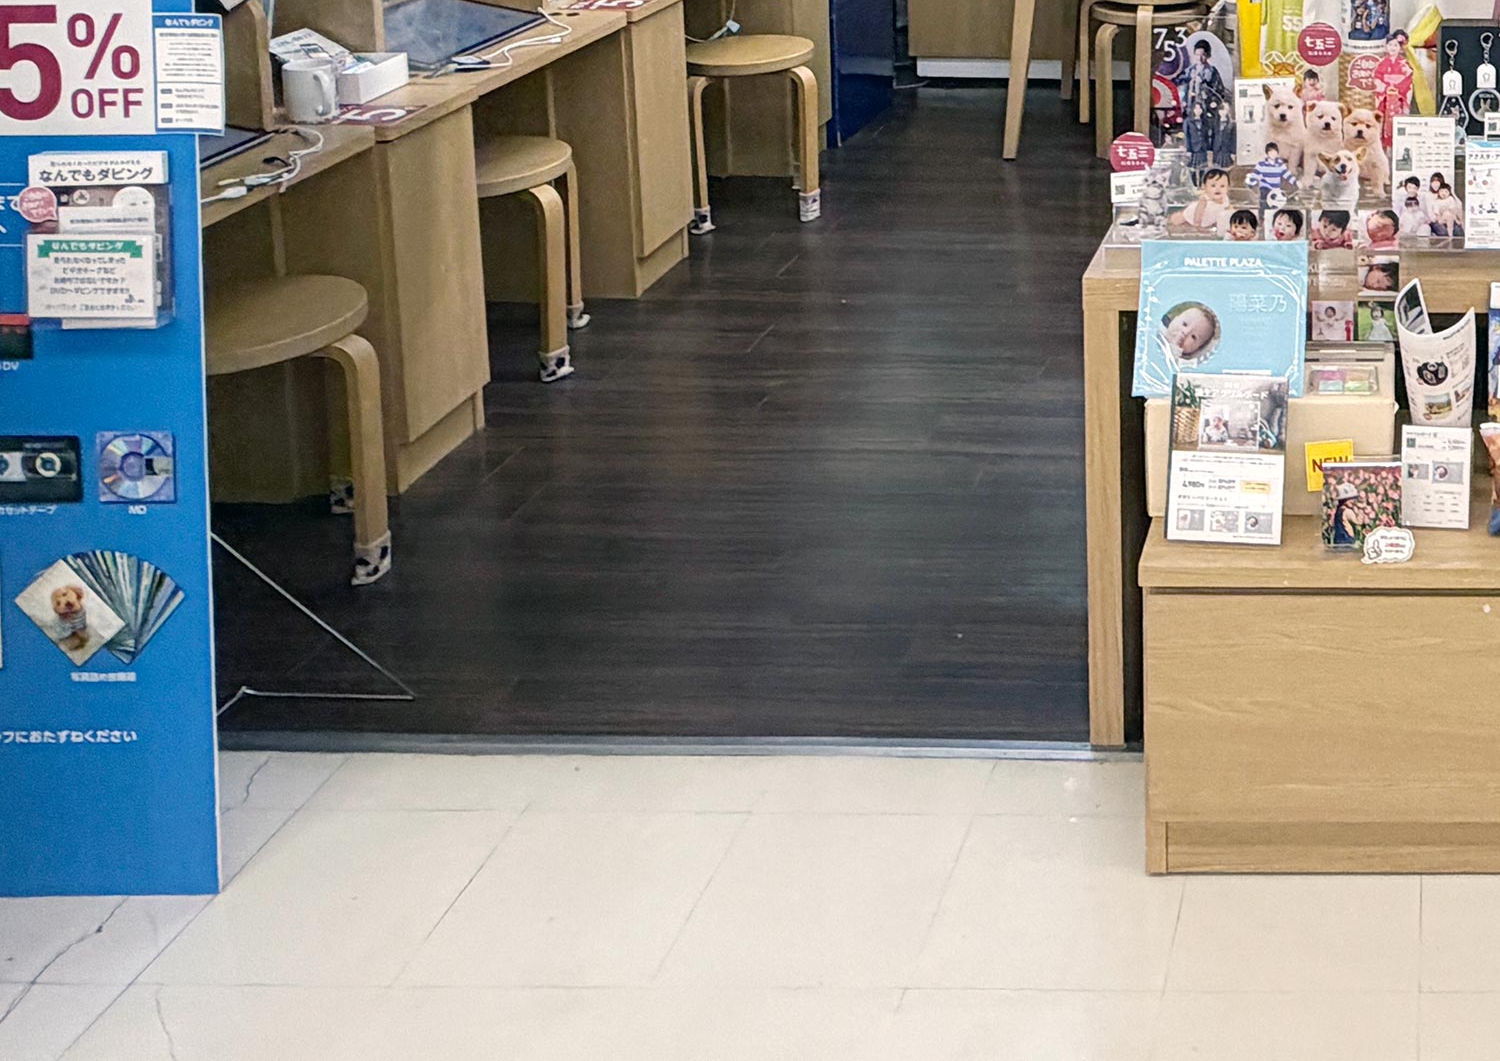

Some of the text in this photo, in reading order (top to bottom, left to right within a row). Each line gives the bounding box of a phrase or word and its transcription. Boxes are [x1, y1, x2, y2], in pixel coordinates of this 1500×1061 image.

[1303, 35, 1336, 50] 七五三
[70, 87, 145, 120] OFF
[1115, 145, 1150, 161] 七五三
[38, 167, 154, 184] なんでもダビング
[1183, 256, 1264, 269] PALETTE PLAZA
[128, 504, 148, 515] MD
